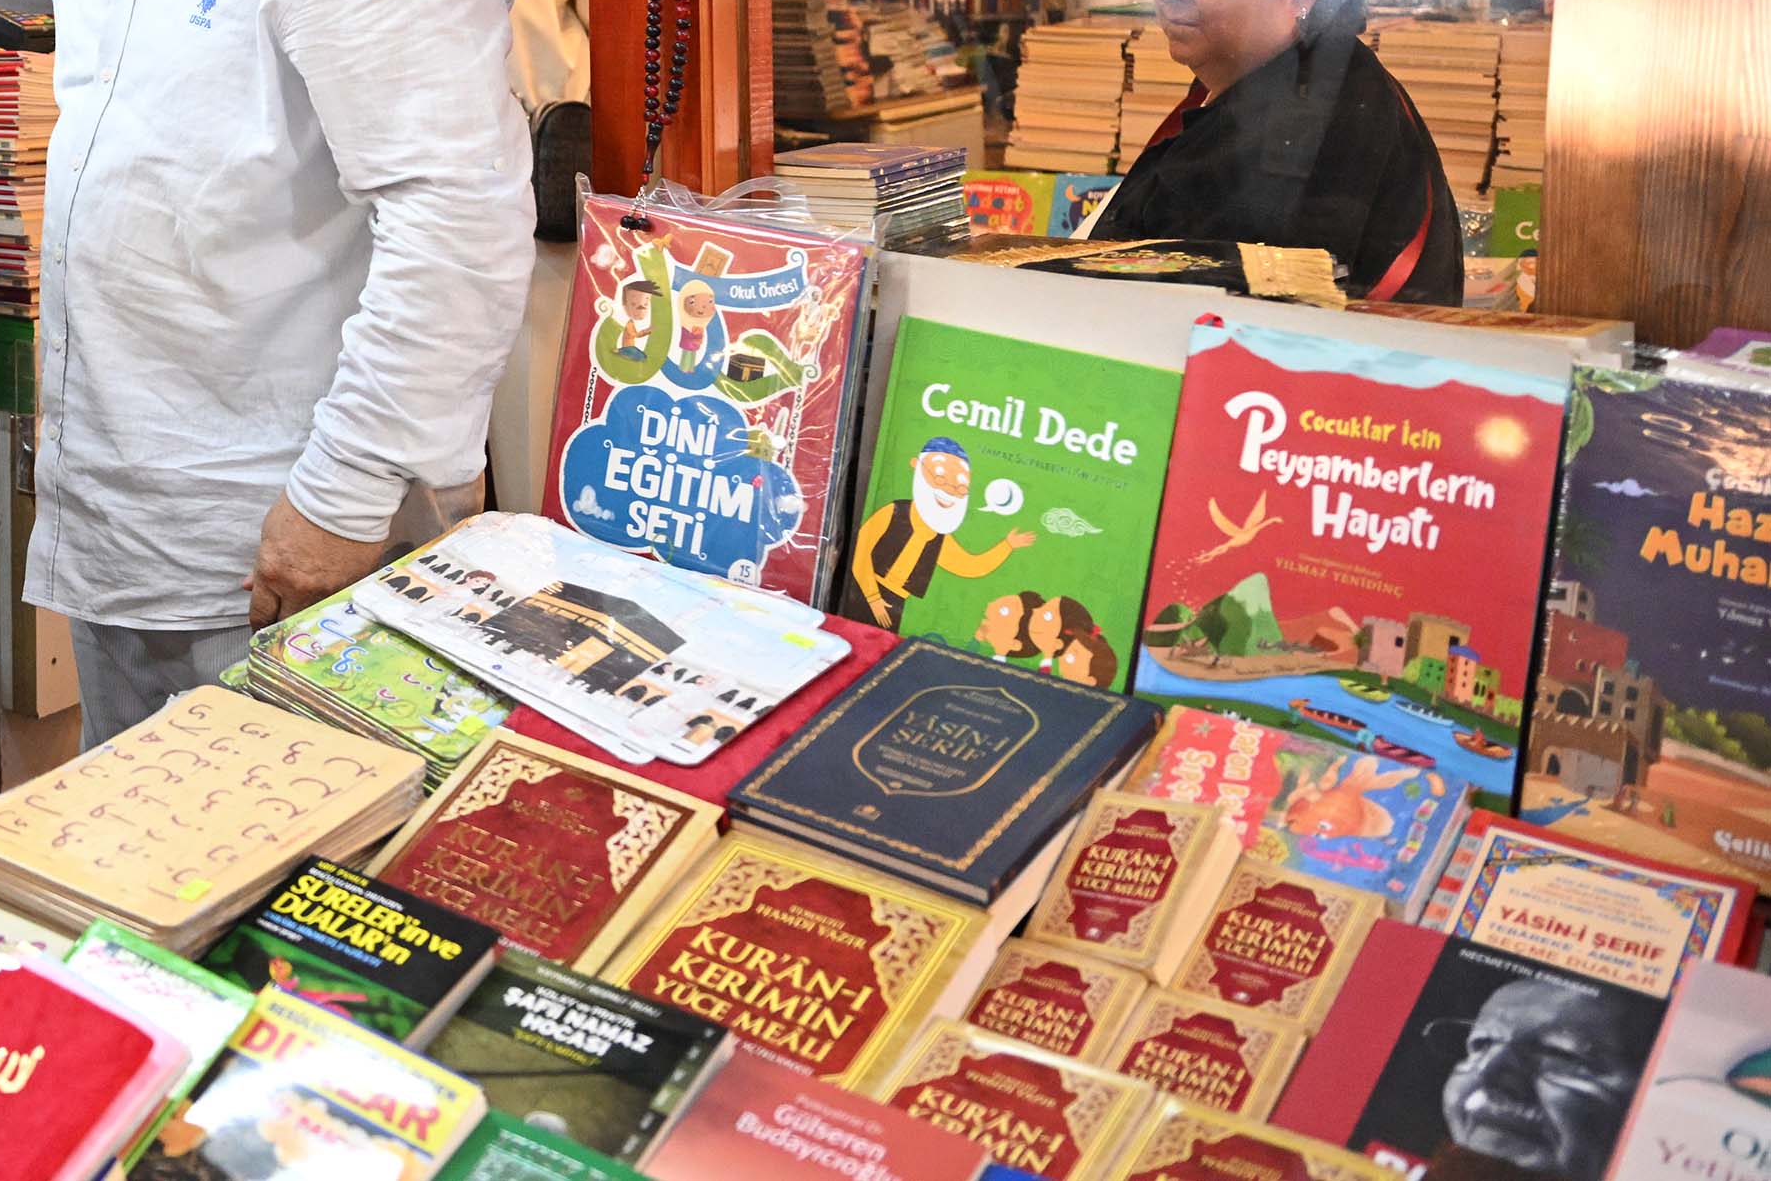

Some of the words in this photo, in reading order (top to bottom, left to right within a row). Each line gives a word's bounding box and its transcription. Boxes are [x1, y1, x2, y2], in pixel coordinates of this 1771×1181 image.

[729, 282, 755, 300] Okul
[758, 277, 799, 298] Öncesi
[922, 383, 1026, 438] Cemil
[1033, 406, 1138, 466] Dede
[1224, 391, 1496, 509] Peygamberlerin
[1299, 409, 1396, 443] Çocuklar
[1402, 420, 1442, 450] İçin
[603, 439, 756, 523] EĞİTİM
[626, 500, 707, 561] SETİ
[1311, 484, 1440, 553] Hayatı
[738, 563, 751, 579] 15
[1639, 526, 1771, 588] Muha
[427, 933, 463, 960] ve
[1500, 904, 1586, 943] YÂSİN-İ
[1592, 927, 1667, 962] ŞERİF
[654, 974, 733, 1021] YÜCE
[669, 950, 855, 1040] KERİM'İN
[689, 925, 874, 1011] KUR'ÂN-I
[917, 1085, 1066, 1154] KUR'ÂN-I
